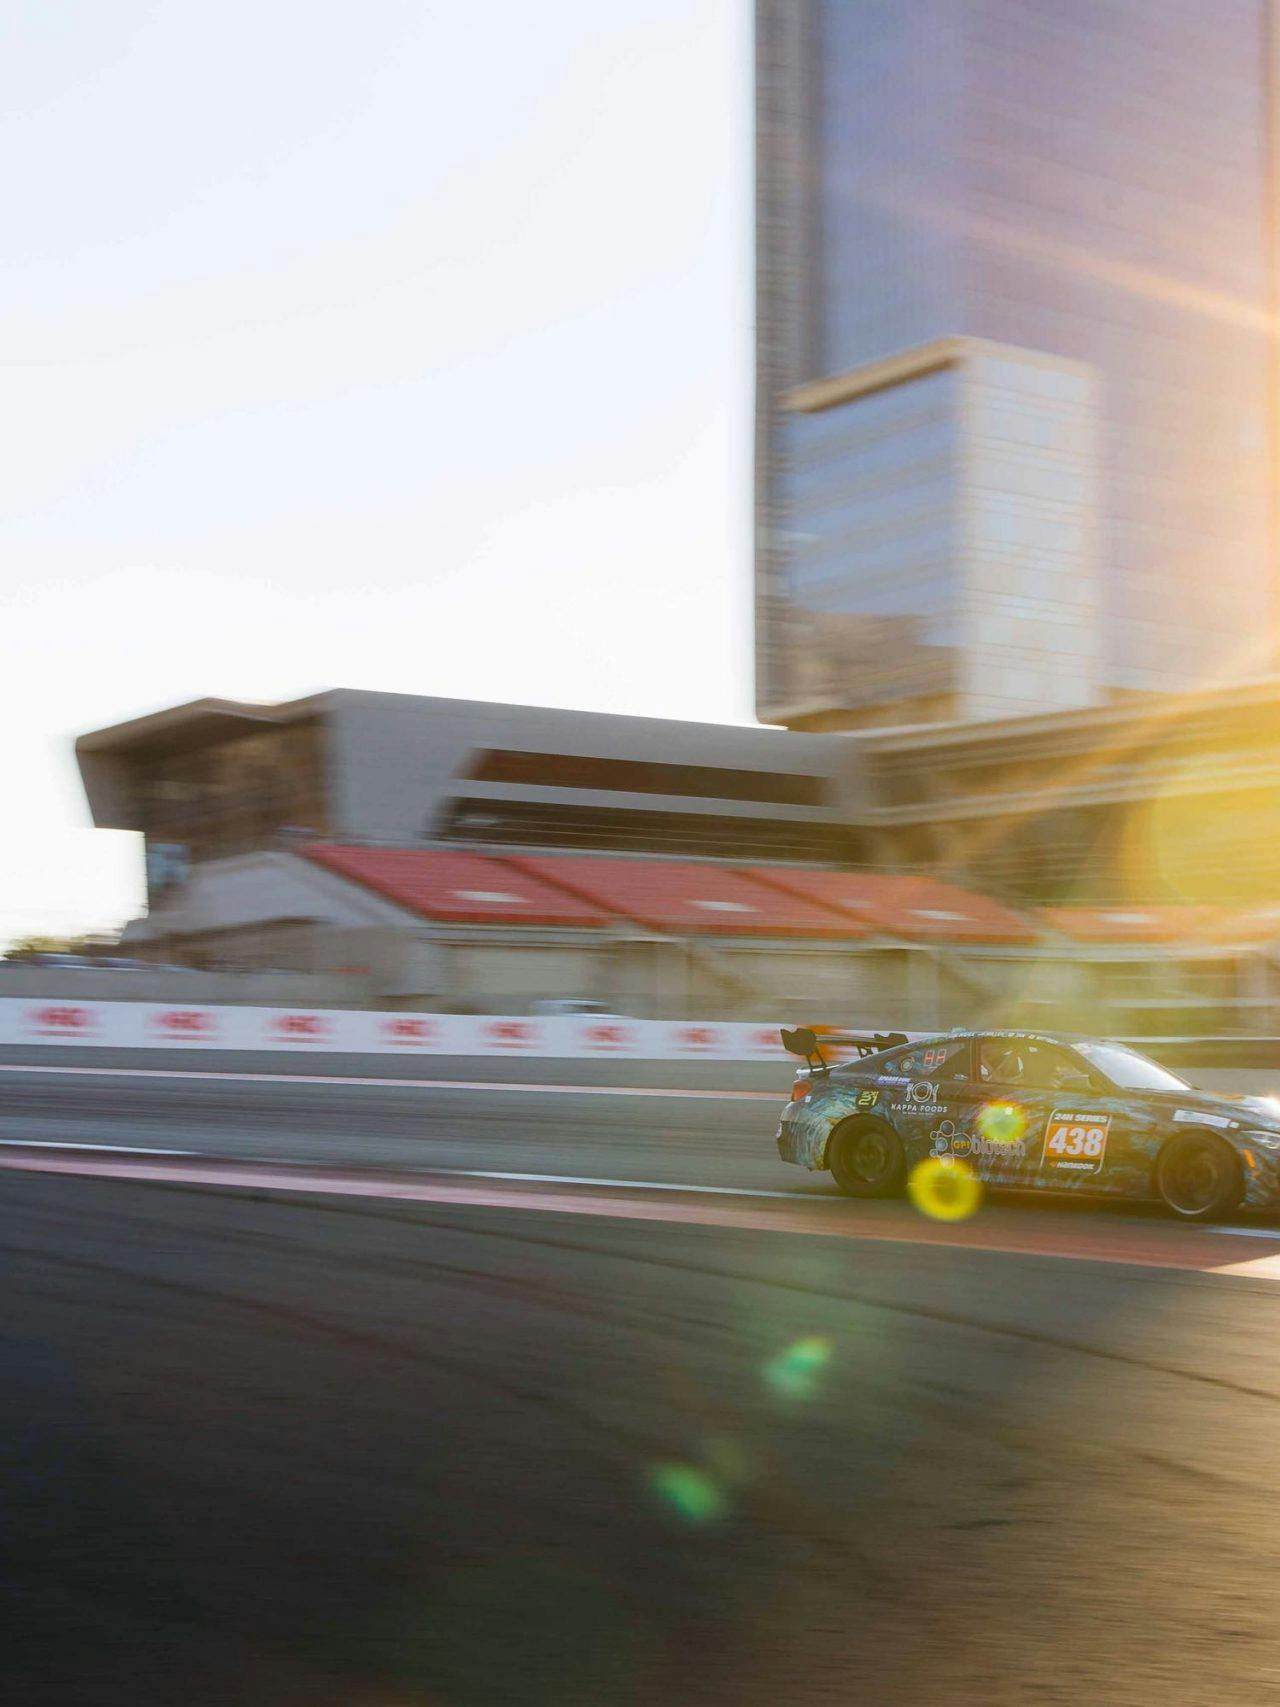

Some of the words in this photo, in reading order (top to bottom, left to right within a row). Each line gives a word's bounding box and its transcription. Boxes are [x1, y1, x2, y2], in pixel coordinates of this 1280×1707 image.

[891, 1103, 917, 1112] KAPPA
[920, 1105, 948, 1113] FOODS
[1055, 1113, 1073, 1121] 24H
[1075, 1114, 1107, 1122] SERIES
[1048, 1127, 1104, 1156] 438
